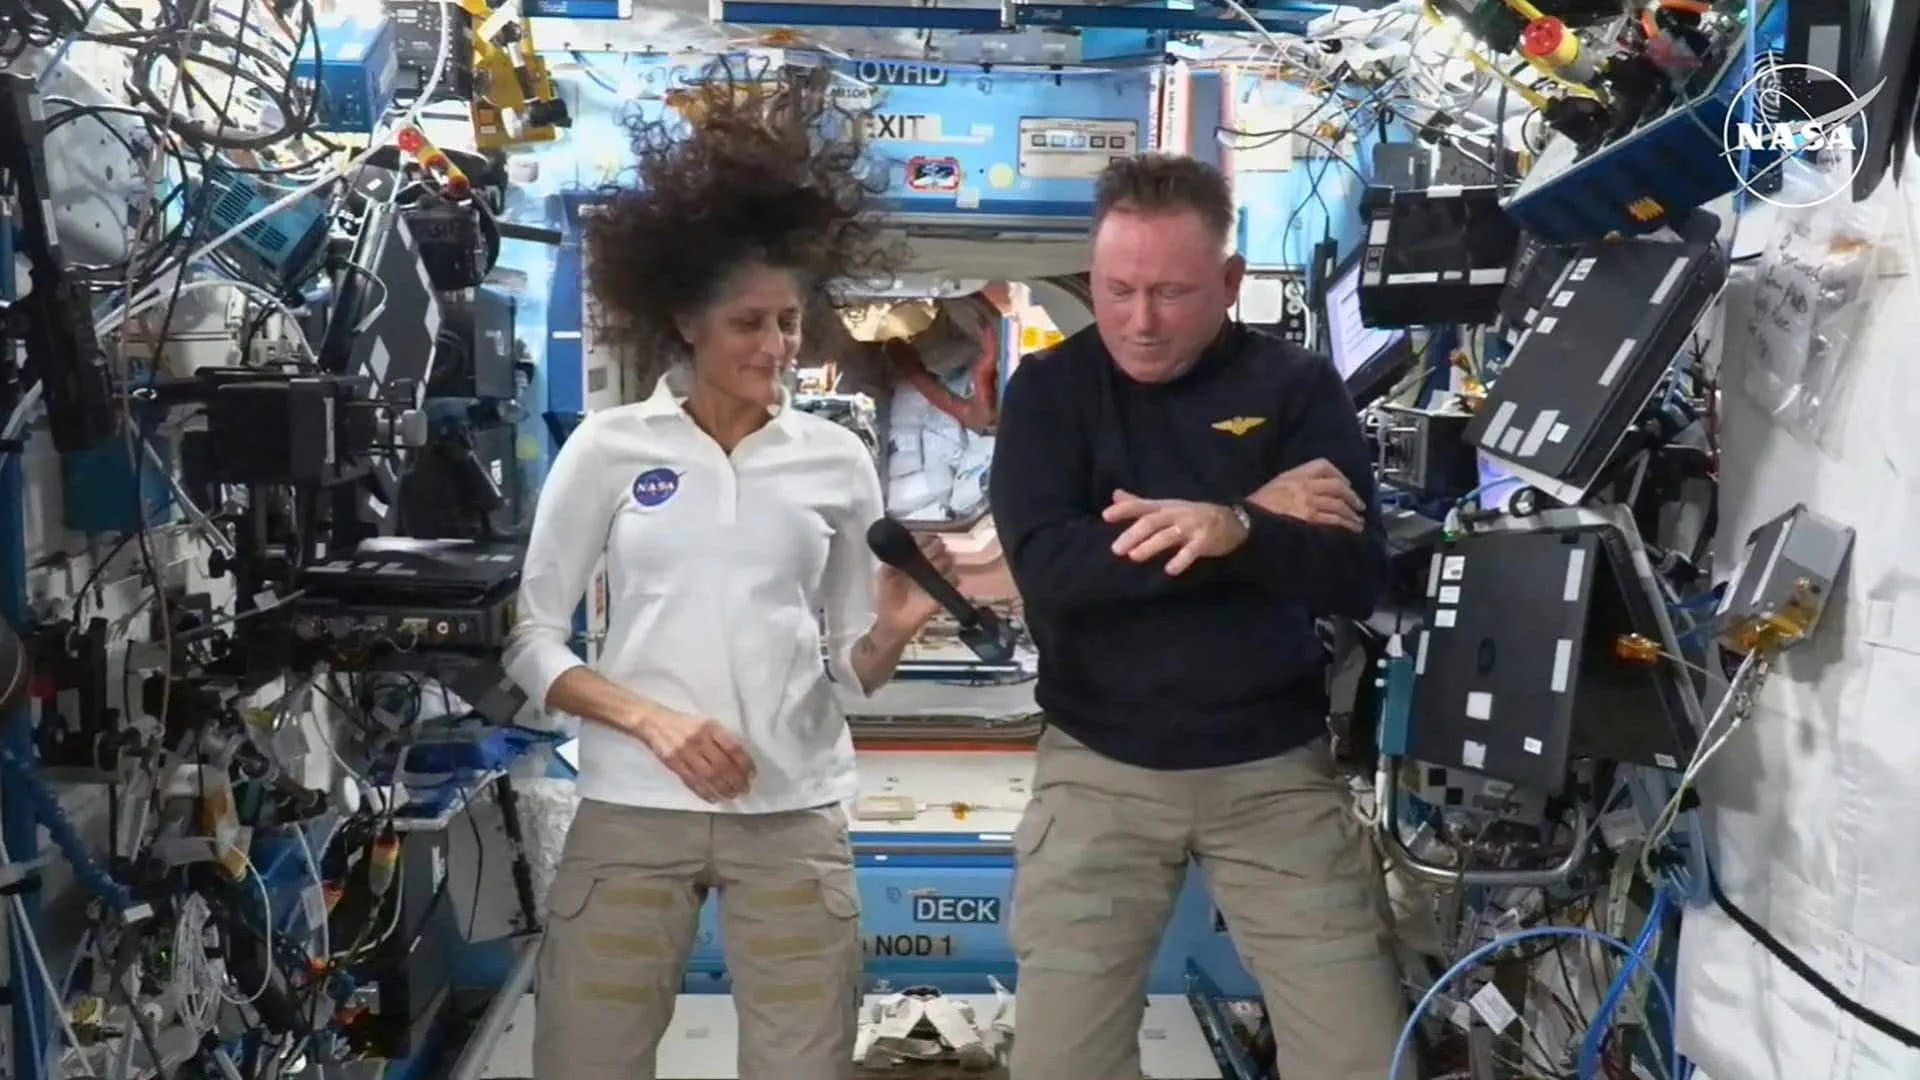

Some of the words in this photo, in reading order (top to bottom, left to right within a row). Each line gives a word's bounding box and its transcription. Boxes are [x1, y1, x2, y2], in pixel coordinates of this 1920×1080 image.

[860, 61, 945, 84] OVHD
[635, 481, 675, 495] NASA
[917, 898, 997, 921] DECK
[875, 934, 933, 957] NOD
[940, 935, 952, 957] 1
